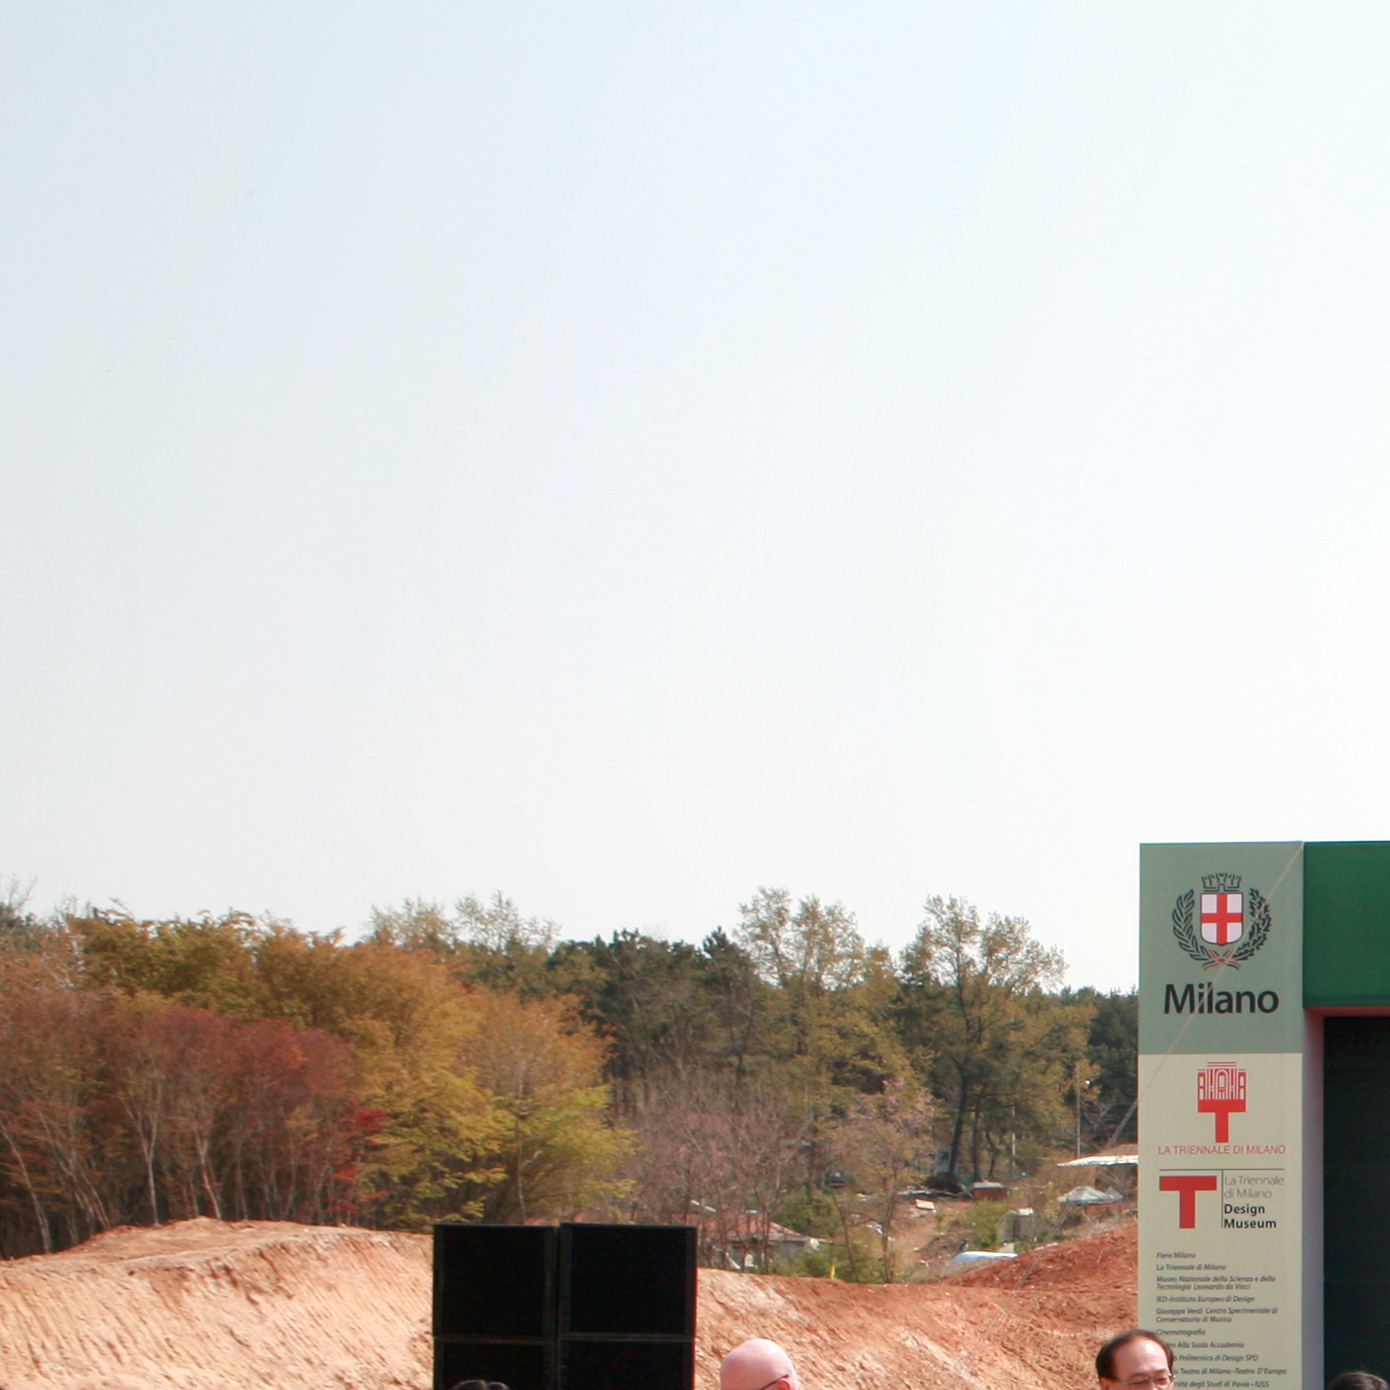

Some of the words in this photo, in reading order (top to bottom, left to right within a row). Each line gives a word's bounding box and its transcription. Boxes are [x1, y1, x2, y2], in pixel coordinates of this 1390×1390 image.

[1164, 983, 1280, 1016] Milano
[1158, 1145, 1171, 1155] LA
[1173, 1145, 1230, 1155] TRIENNALE
[1233, 1145, 1243, 1154] DI
[1246, 1144, 1286, 1155] MILANO
[1224, 1176, 1236, 1186] La
[1239, 1175, 1285, 1186] Triennale
[1224, 1189, 1234, 1199] di
[1236, 1188, 1273, 1199] Milano
[1224, 1203, 1266, 1217] Design
[1224, 1218, 1277, 1229] Museum
